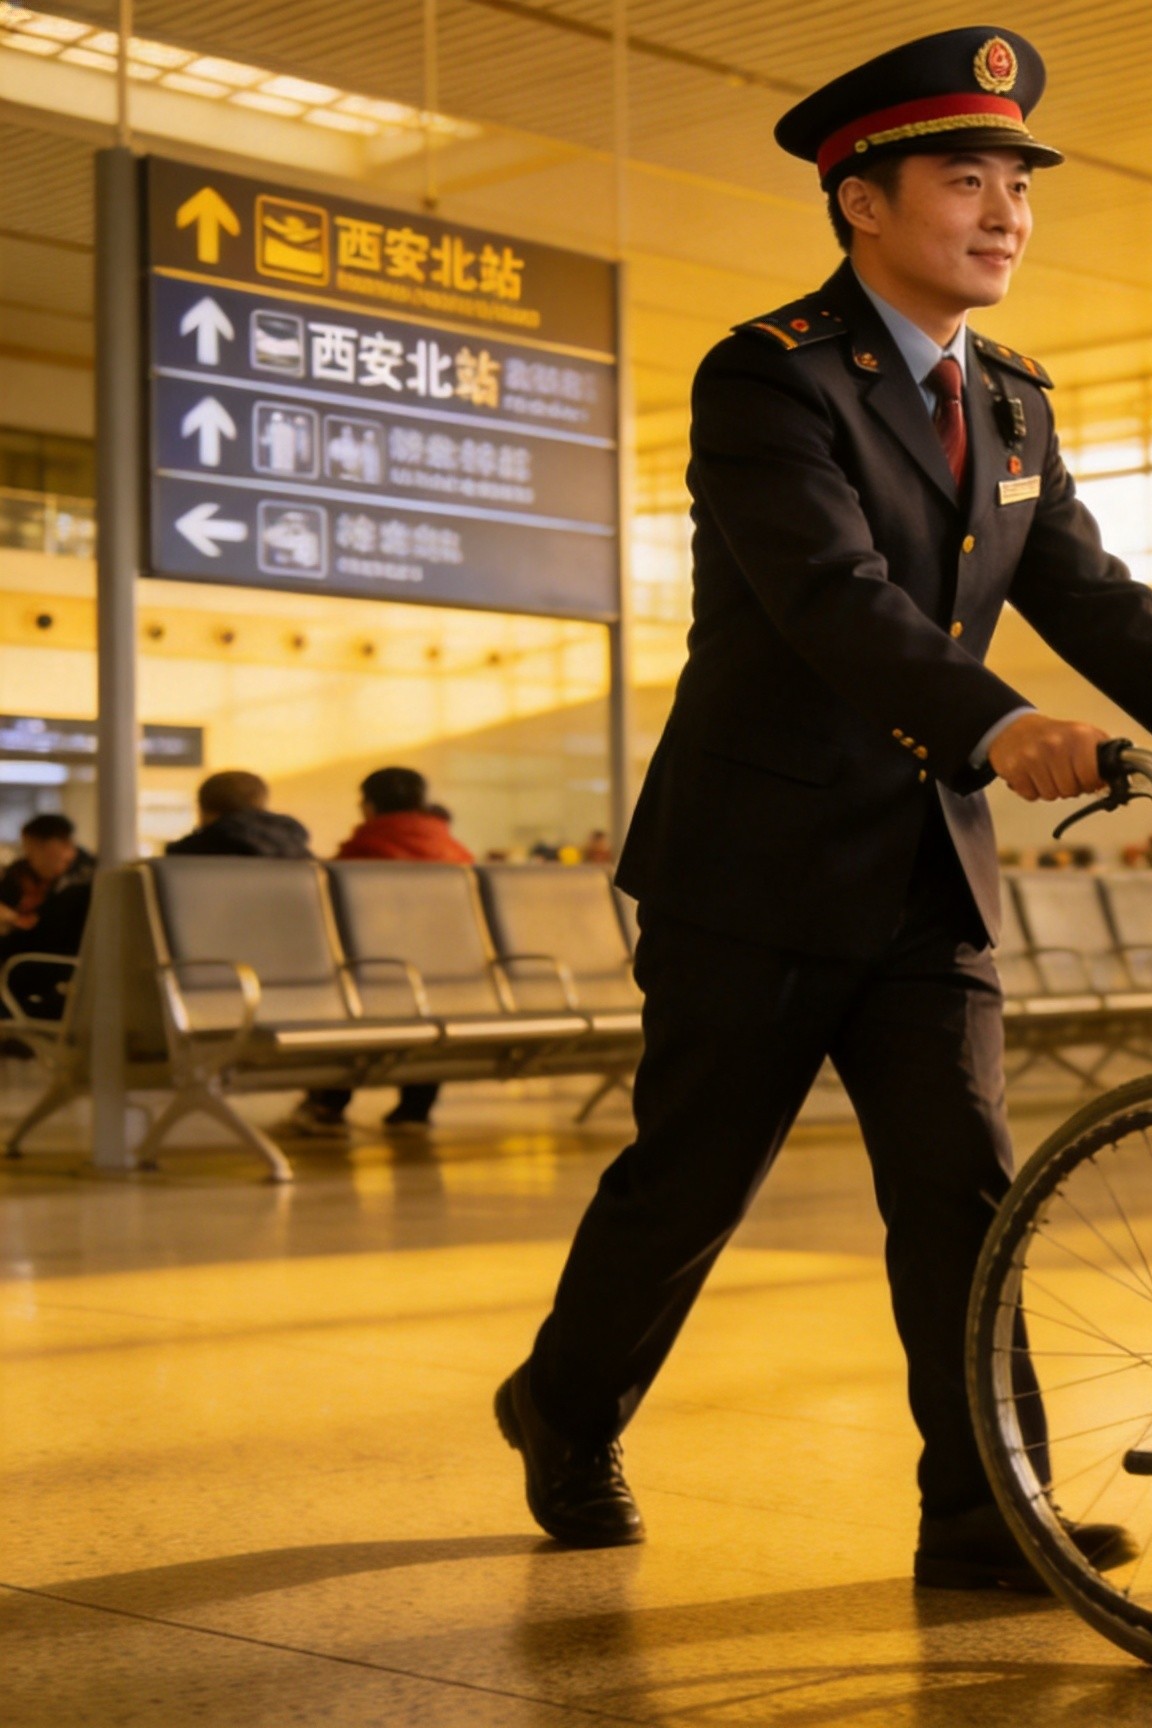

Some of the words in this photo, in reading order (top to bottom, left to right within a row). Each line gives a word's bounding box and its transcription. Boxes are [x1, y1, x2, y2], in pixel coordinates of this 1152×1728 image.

[335, 217, 524, 300] 西安北站
[308, 323, 499, 408] 西安北站
